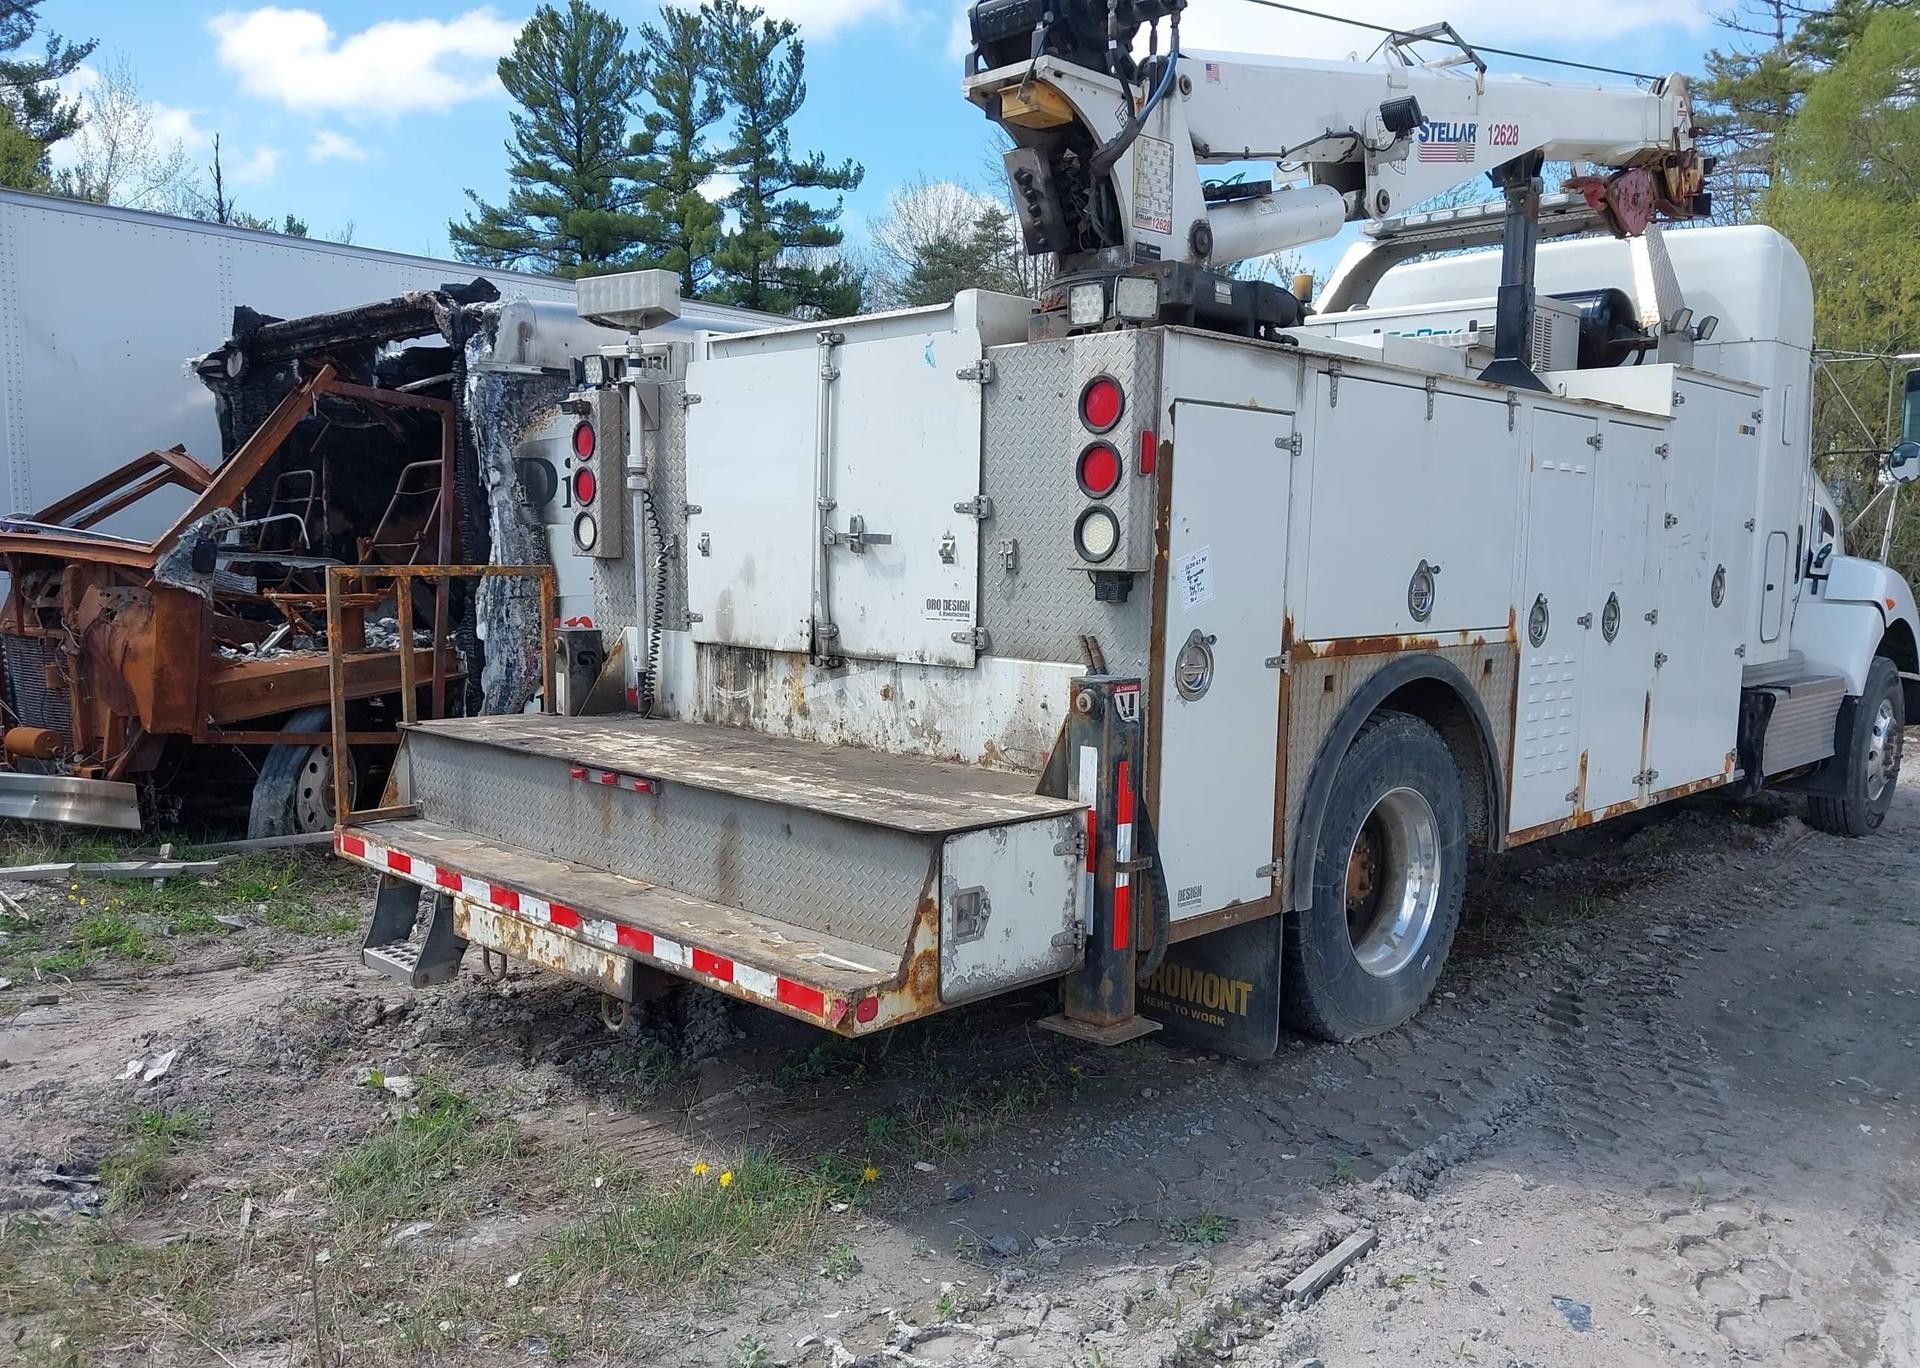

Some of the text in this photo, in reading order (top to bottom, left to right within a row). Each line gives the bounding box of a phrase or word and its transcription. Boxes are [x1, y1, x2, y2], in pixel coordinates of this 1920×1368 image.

[1418, 115, 1477, 143] STELLAR
[1488, 124, 1519, 146] 12628
[926, 598, 970, 612] ORO DESIGN
[1177, 885, 1203, 902] DESIGN
[1143, 994, 1226, 1027] HERE TO WORK
